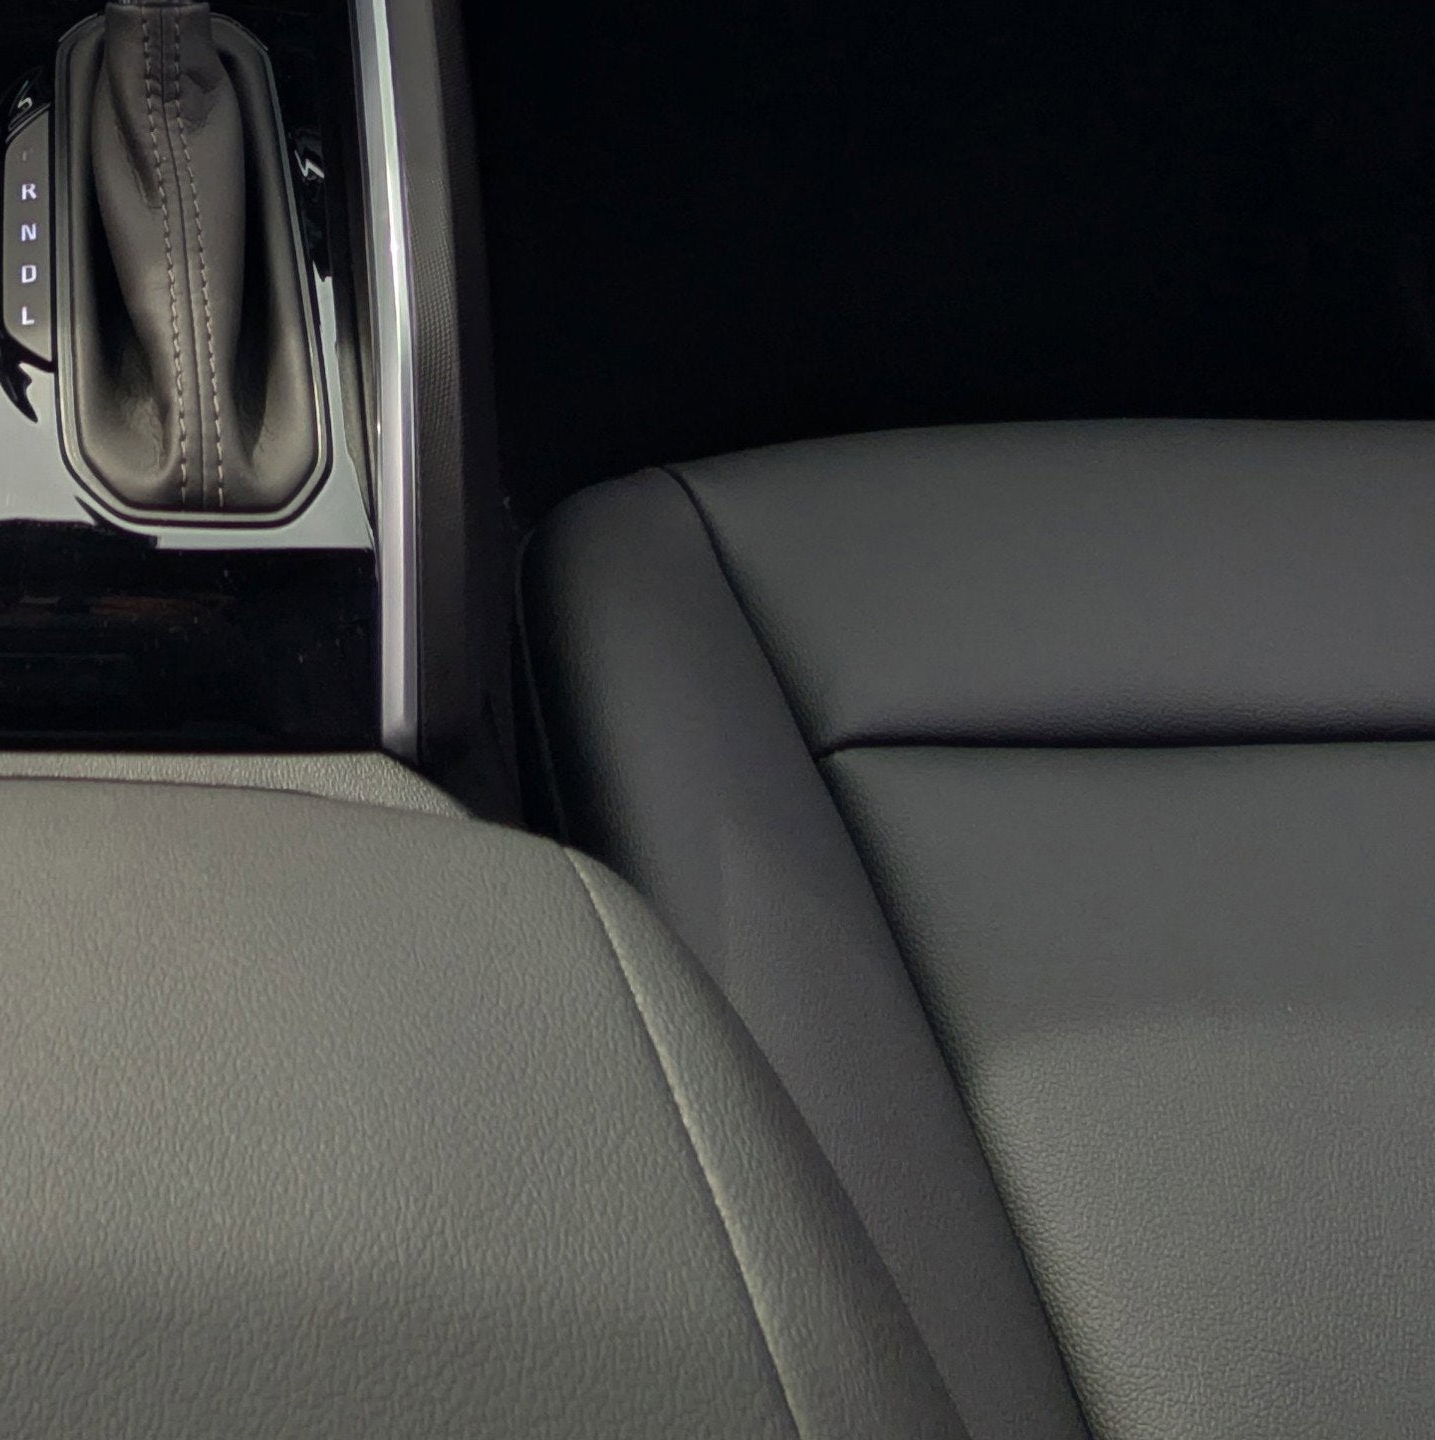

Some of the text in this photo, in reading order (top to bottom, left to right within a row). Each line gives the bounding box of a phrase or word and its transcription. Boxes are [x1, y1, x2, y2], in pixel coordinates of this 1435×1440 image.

[21, 183, 37, 200] R
[21, 223, 37, 241] N
[21, 264, 37, 283] D
[21, 306, 35, 325] L
